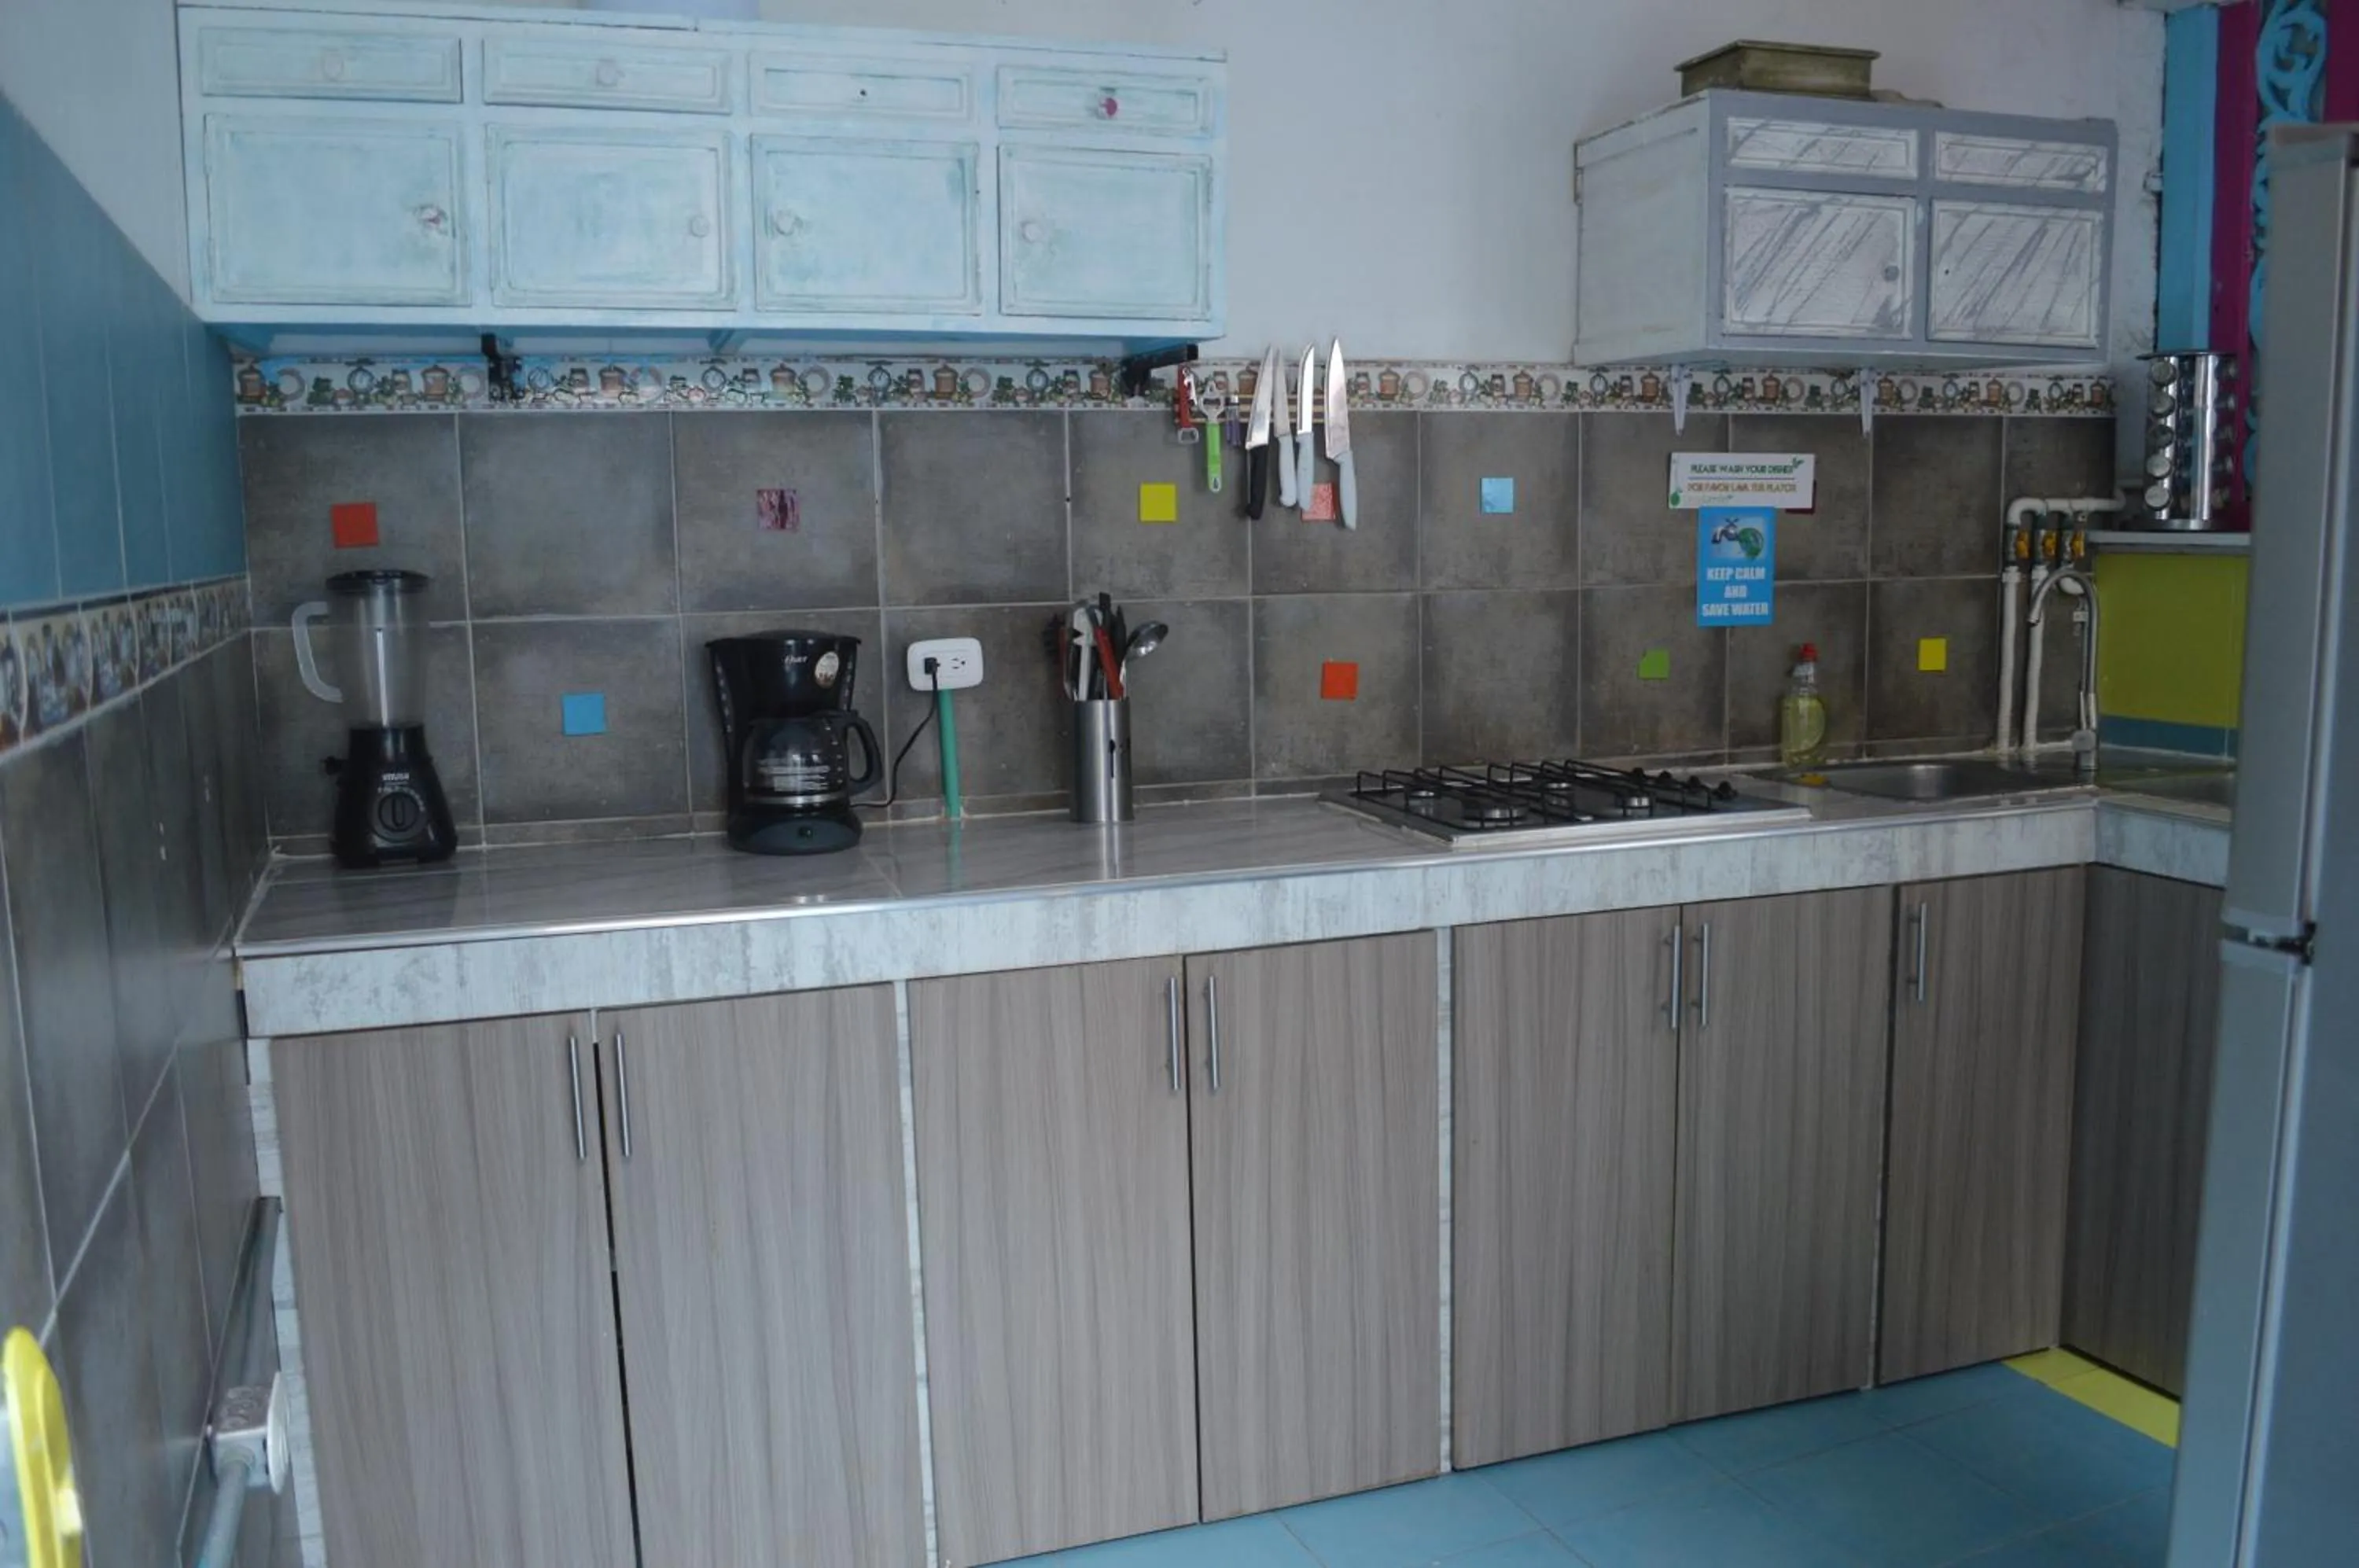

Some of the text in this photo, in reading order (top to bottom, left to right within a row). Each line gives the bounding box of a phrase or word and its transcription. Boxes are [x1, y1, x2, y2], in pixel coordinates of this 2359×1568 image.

[1719, 465, 1743, 473] WASH
[1746, 465, 1766, 473] YOUR
[1706, 567, 1765, 581] KEEP CALM
[1724, 585, 1747, 598] AND
[1702, 602, 1768, 617] SAVE WATER
